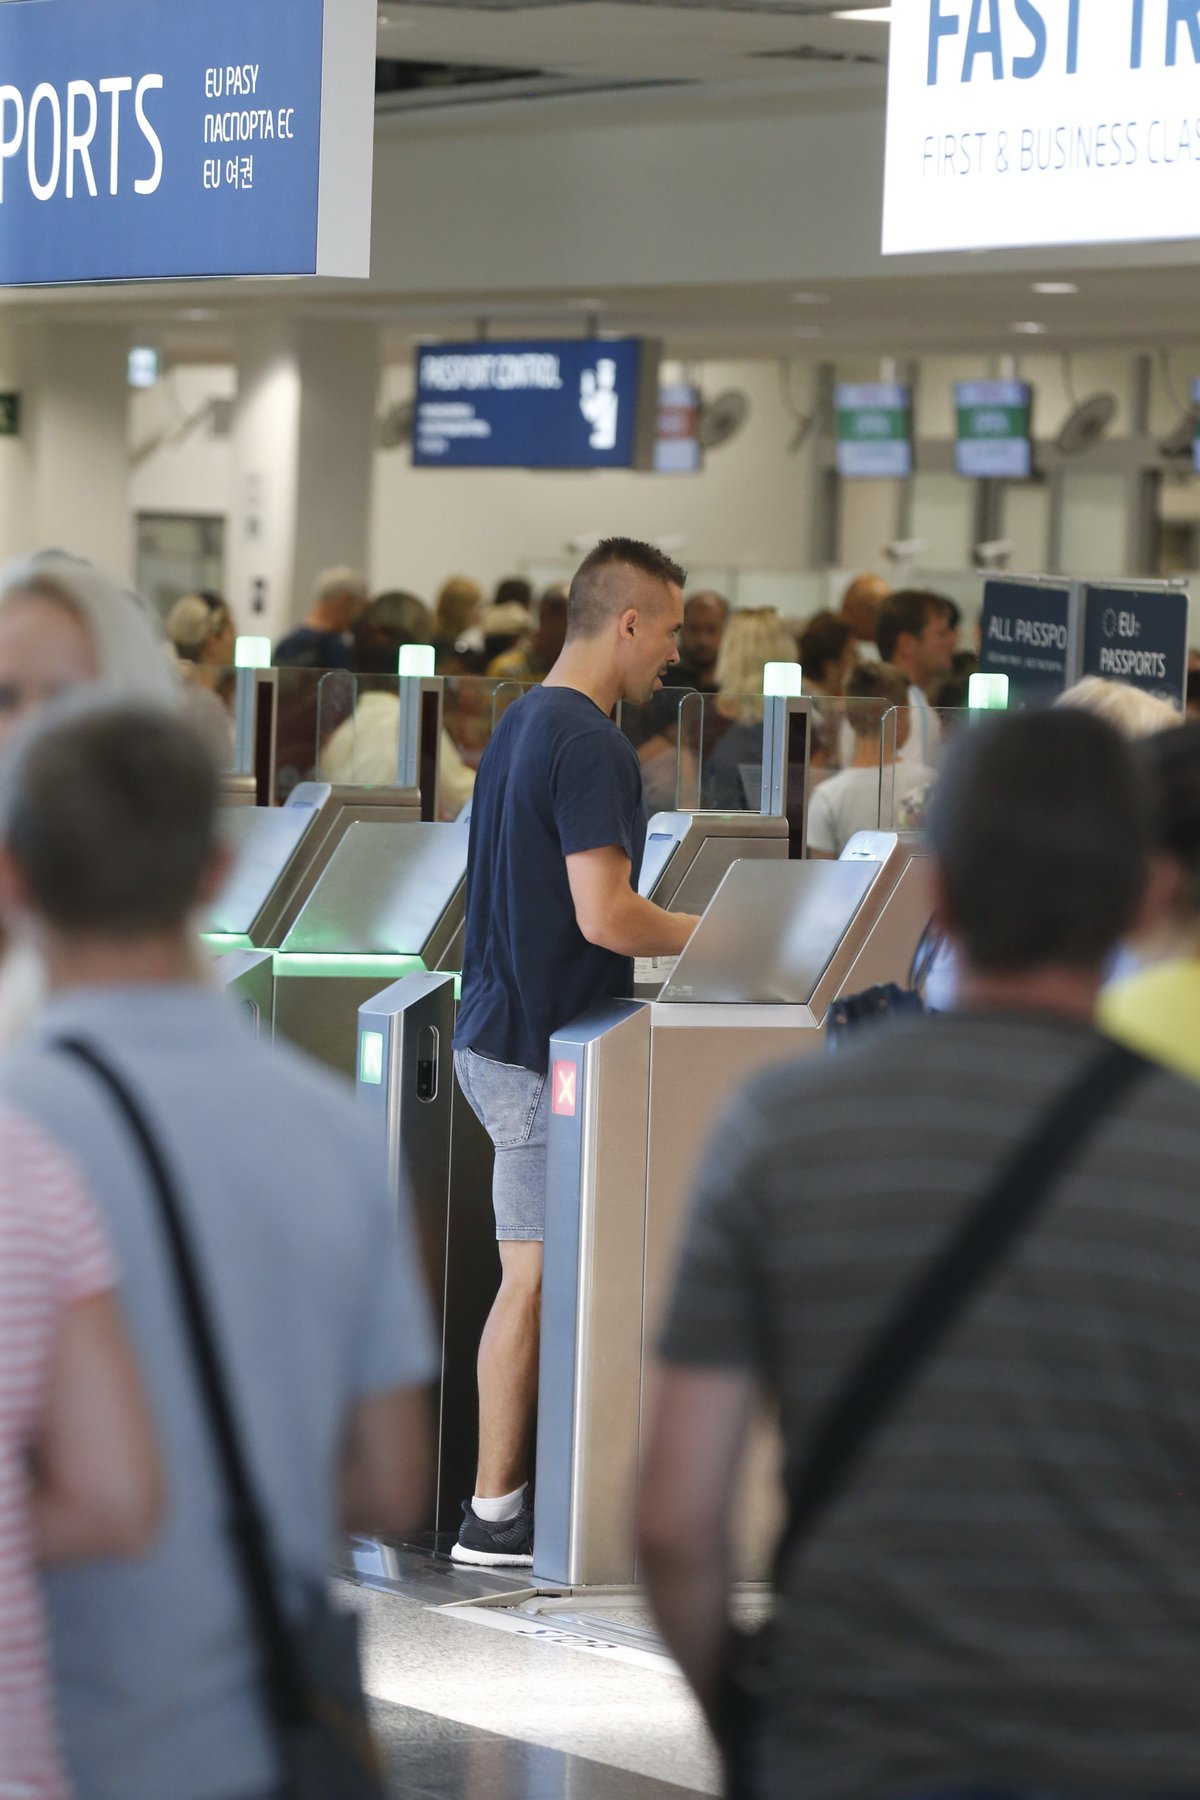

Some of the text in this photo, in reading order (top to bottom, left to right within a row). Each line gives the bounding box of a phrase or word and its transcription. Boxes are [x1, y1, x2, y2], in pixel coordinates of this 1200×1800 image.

[205, 64, 259, 98] EU PASY
[0, 73, 164, 204] PORTS
[204, 108, 295, 143] ПАСПОРТА ЕС
[922, 132, 987, 177] FIRST
[995, 130, 1010, 173] &
[1019, 121, 1138, 172] BUSINESS
[203, 154, 253, 190] EU 여권
[986, 615, 1013, 641] ALL
[1100, 647, 1166, 679] PASSPORTS
